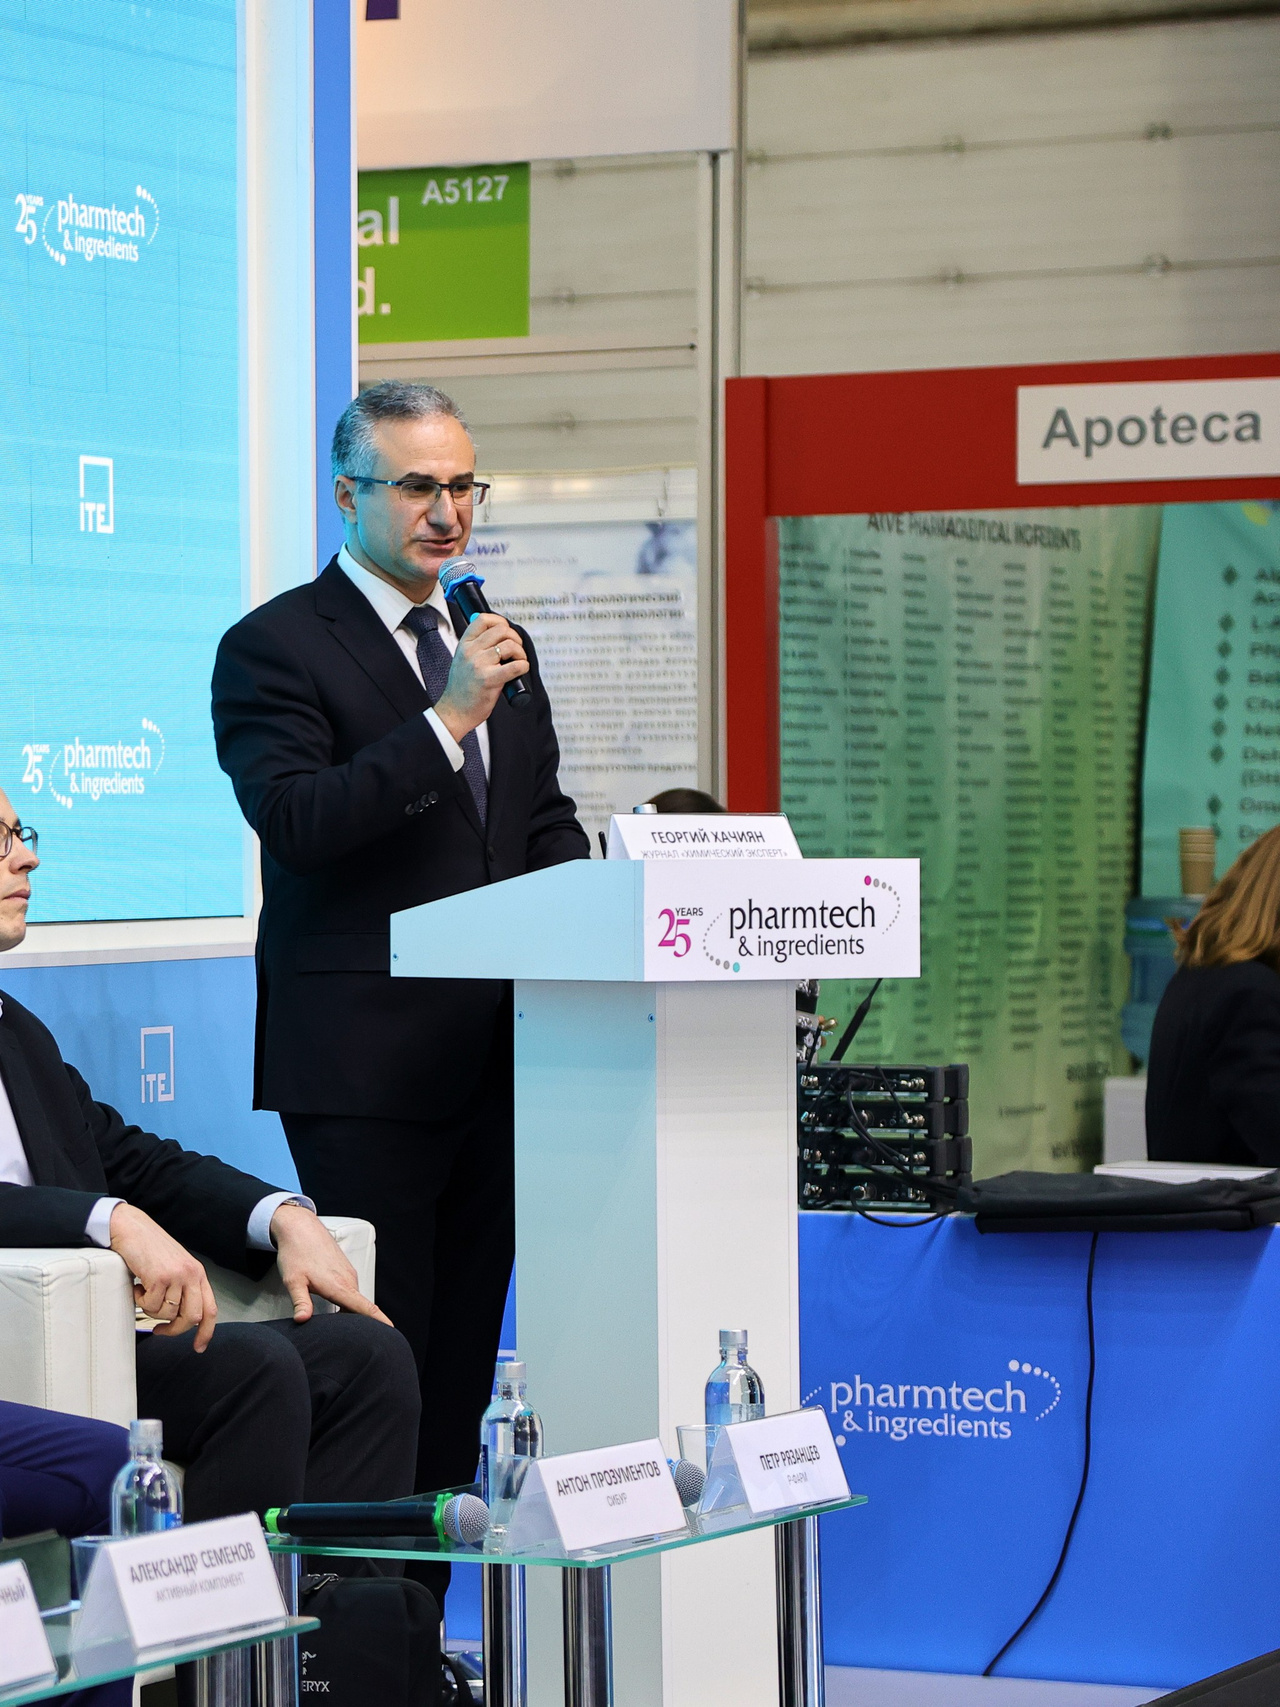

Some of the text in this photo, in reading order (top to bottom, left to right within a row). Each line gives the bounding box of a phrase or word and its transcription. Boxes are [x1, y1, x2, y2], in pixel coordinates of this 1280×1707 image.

[422, 176, 509, 205] A5127
[15, 193, 37, 244] 25
[58, 193, 145, 237] pharmtech
[63, 229, 139, 262] & ingredients
[1042, 405, 1263, 460] Apoteca
[22, 744, 43, 794] 25
[64, 736, 151, 776] pharmtech
[70, 771, 145, 801] & ingredients
[641, 849, 679, 859] ЖУРНАЛ
[651, 828, 766, 844] ГЕОРГИЙ ХАЧИЯН
[658, 907, 704, 958] 25 YEARS
[729, 897, 876, 939] pharmtech
[738, 933, 865, 963] & ingredients
[830, 1374, 1027, 1414] pharmtech
[842, 1409, 1012, 1442] & ingredients
[759, 1444, 821, 1471] ПЕТР РЯЗАНЦЕВ
[556, 1460, 661, 1496] АНТОН ПРОЗУМЕНТОВ
[606, 1492, 628, 1507] СИБУР
[130, 1541, 256, 1583] АЛЕКСАНДР СЕМЕНОВ
